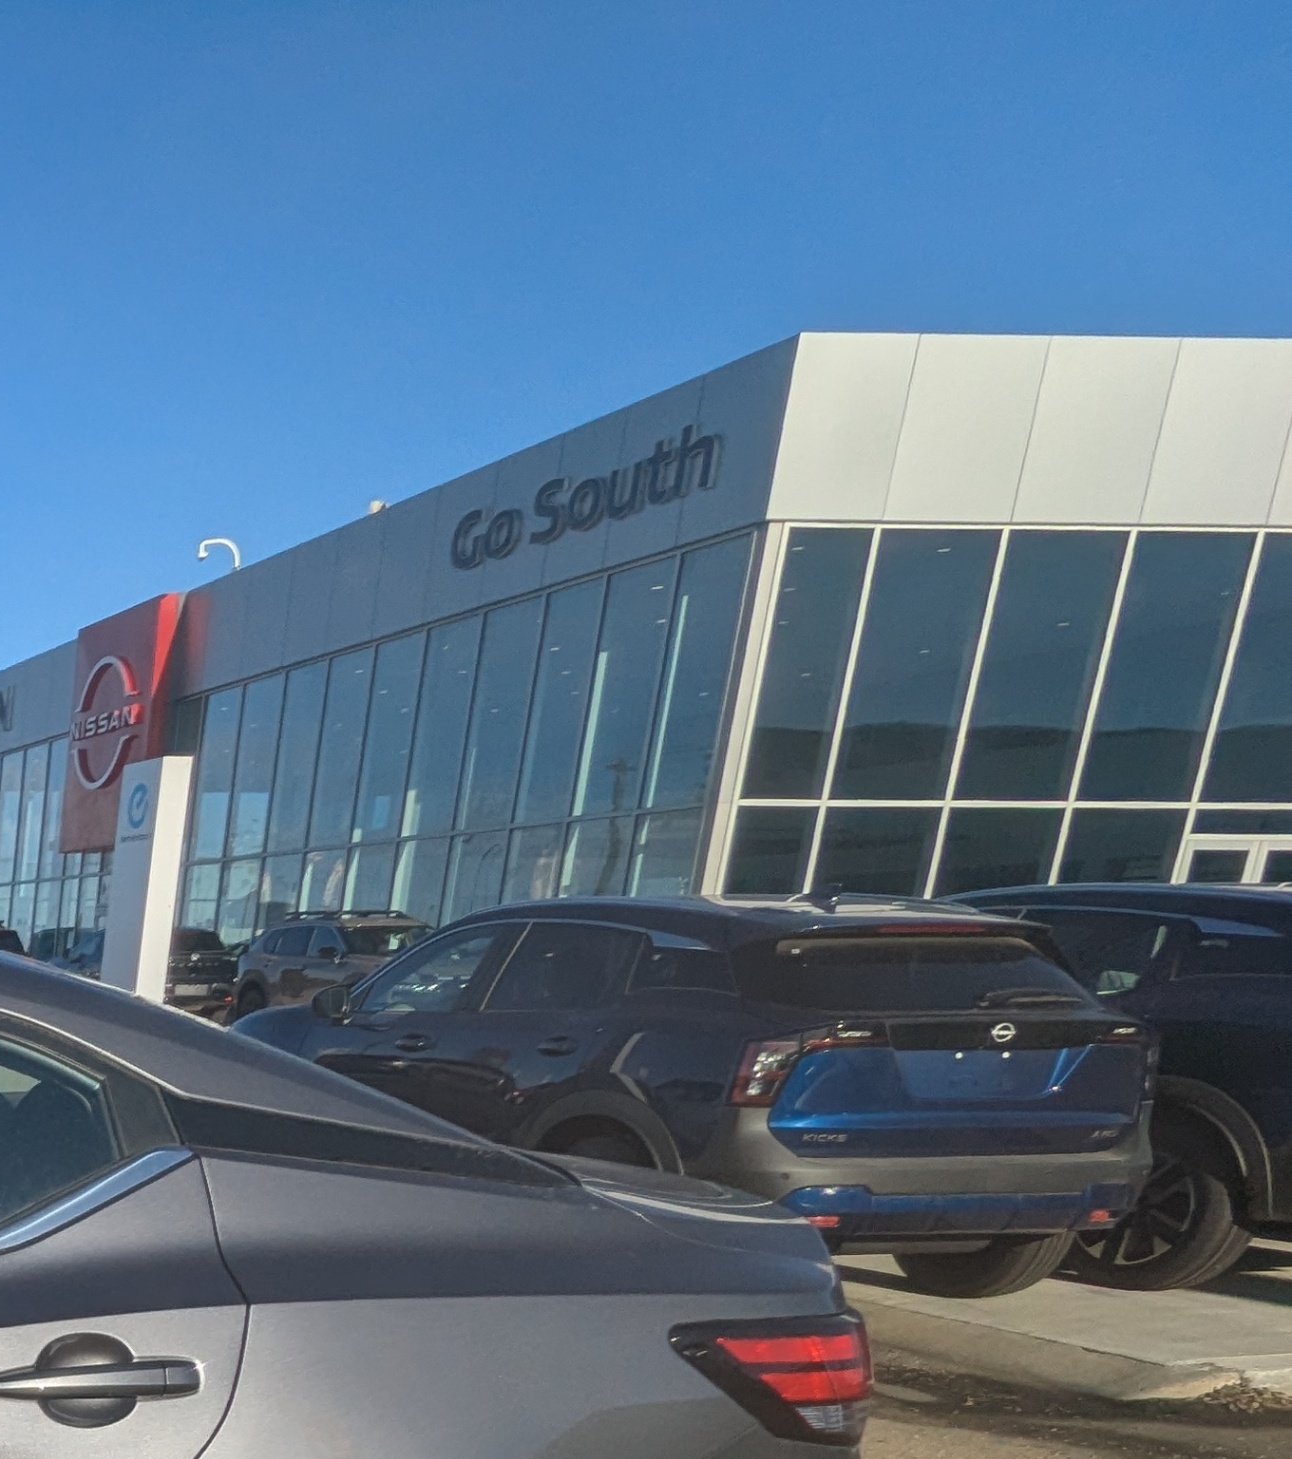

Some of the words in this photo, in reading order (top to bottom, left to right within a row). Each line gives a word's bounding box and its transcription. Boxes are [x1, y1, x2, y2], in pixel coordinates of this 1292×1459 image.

[451, 508, 524, 570] Go
[529, 424, 721, 544] South
[69, 704, 143, 741] NISSAN
